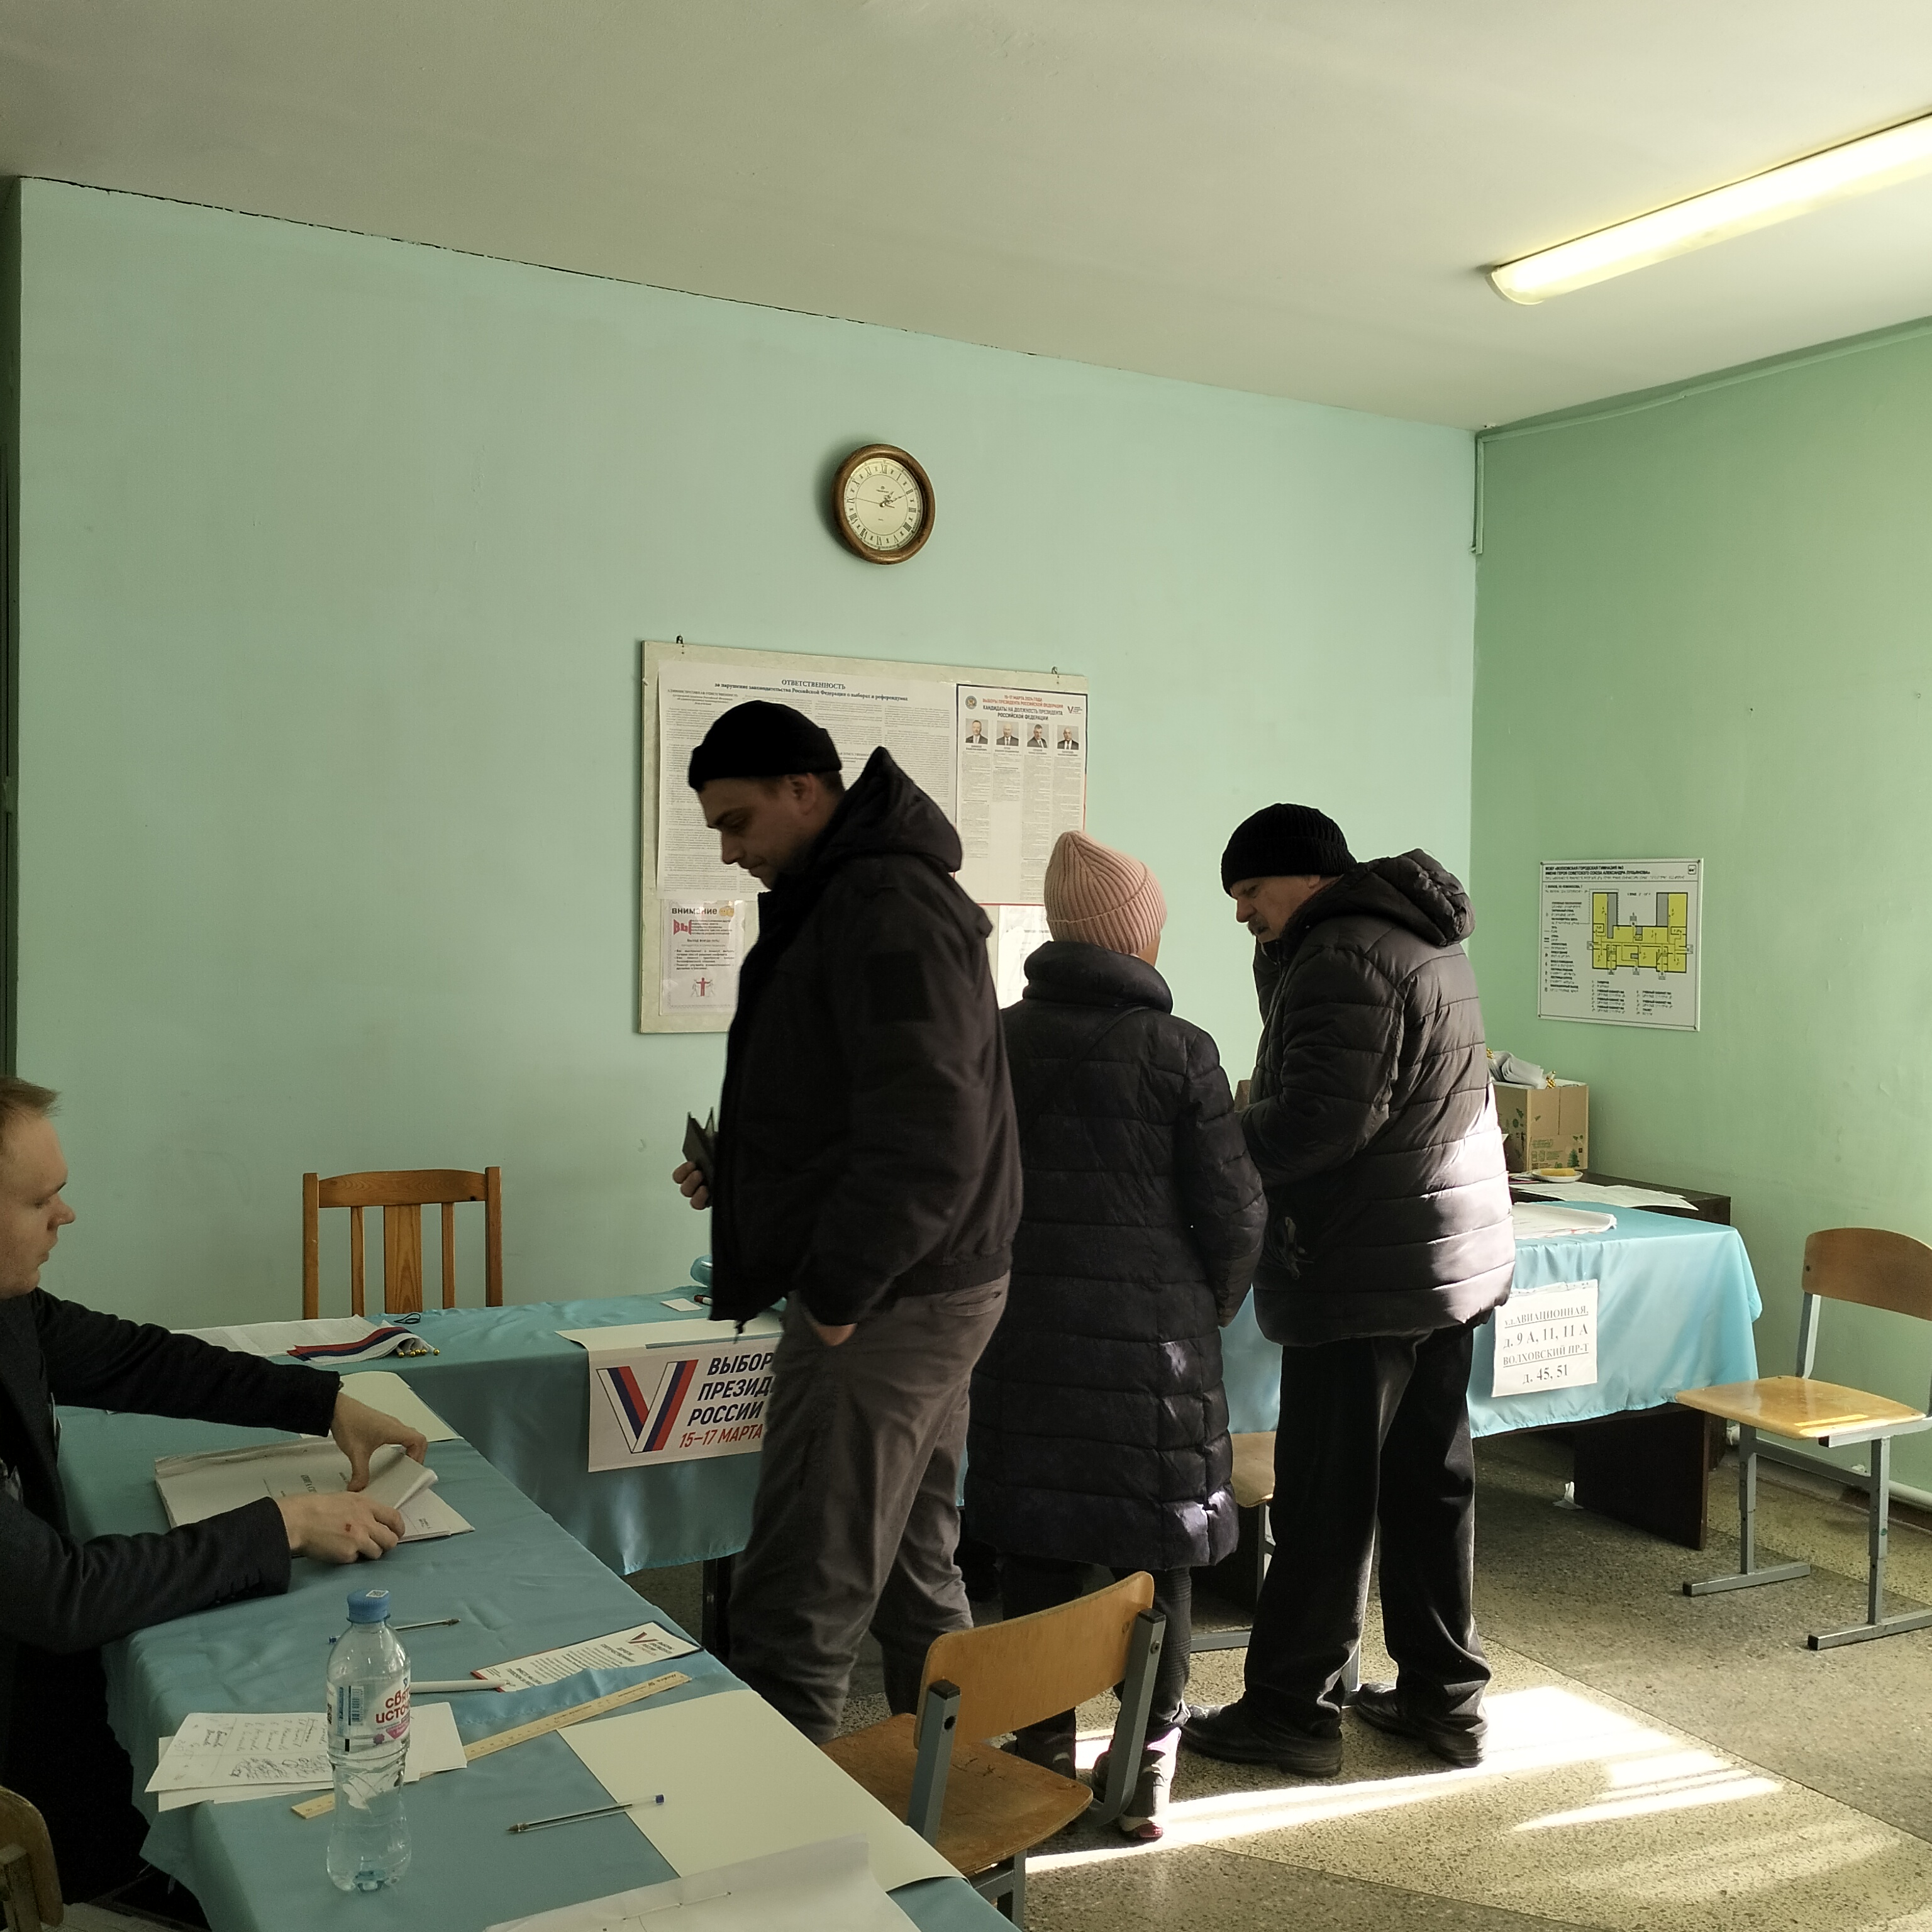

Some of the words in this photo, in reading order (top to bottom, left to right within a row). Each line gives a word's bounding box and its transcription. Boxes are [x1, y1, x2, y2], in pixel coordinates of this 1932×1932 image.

[781, 679, 846, 689] ОТВЕТСТВЕННОСТЬ
[1503, 1338, 1513, 1349] д.
[1517, 1332, 1523, 1345] 9
[1526, 1331, 1538, 1343] А,
[1543, 1327, 1558, 1340] 11,
[1563, 1324, 1574, 1338] 11
[1579, 1323, 1588, 1335] А
[707, 1352, 774, 1376] ВЫБОР
[1503, 1344, 1565, 1365] ВОЛХОВСКИЙ
[1568, 1343, 1589, 1353] ПР-Т
[1523, 1374, 1533, 1384] д.
[1536, 1367, 1553, 1380] 45,
[1557, 1364, 1568, 1377] 51
[697, 1375, 774, 1401] ПРЕЗИД
[687, 1401, 765, 1427] РОССИИ
[718, 1424, 763, 1443] МАРТА
[386, 1687, 409, 1708] СВЯТ
